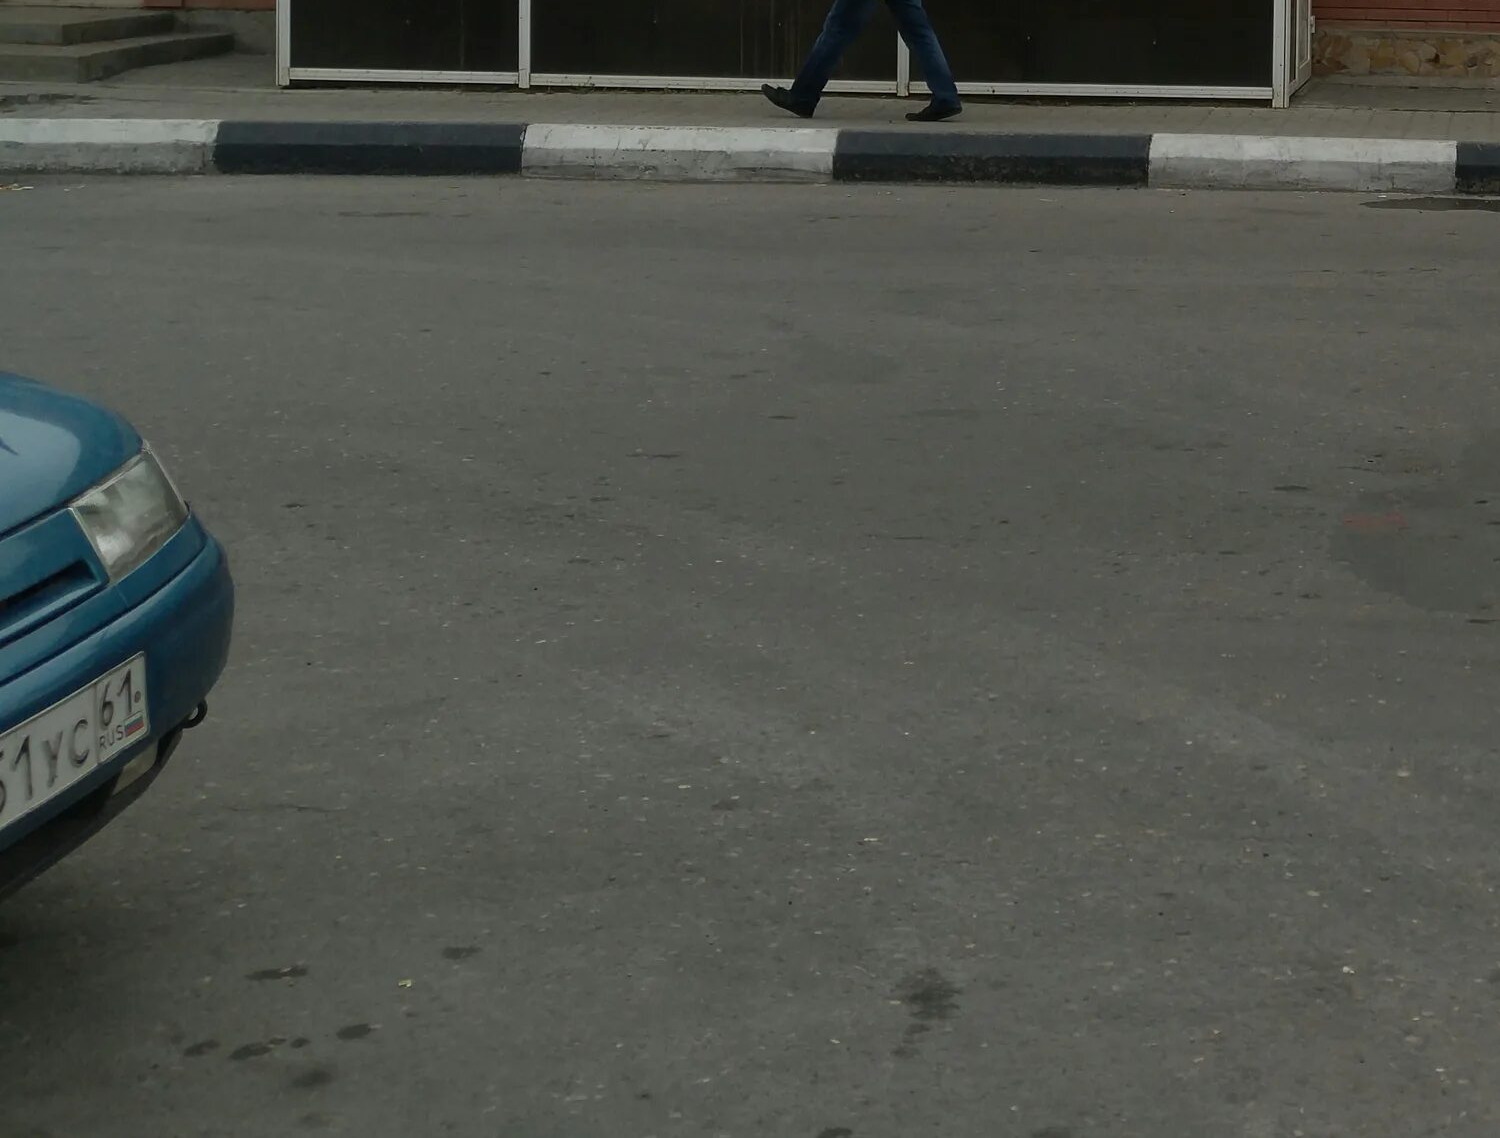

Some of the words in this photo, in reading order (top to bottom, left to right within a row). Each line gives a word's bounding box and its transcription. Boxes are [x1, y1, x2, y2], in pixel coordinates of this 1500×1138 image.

[100, 668, 133, 728] 61
[0, 719, 90, 814] 1УС
[99, 724, 124, 751] RUS
